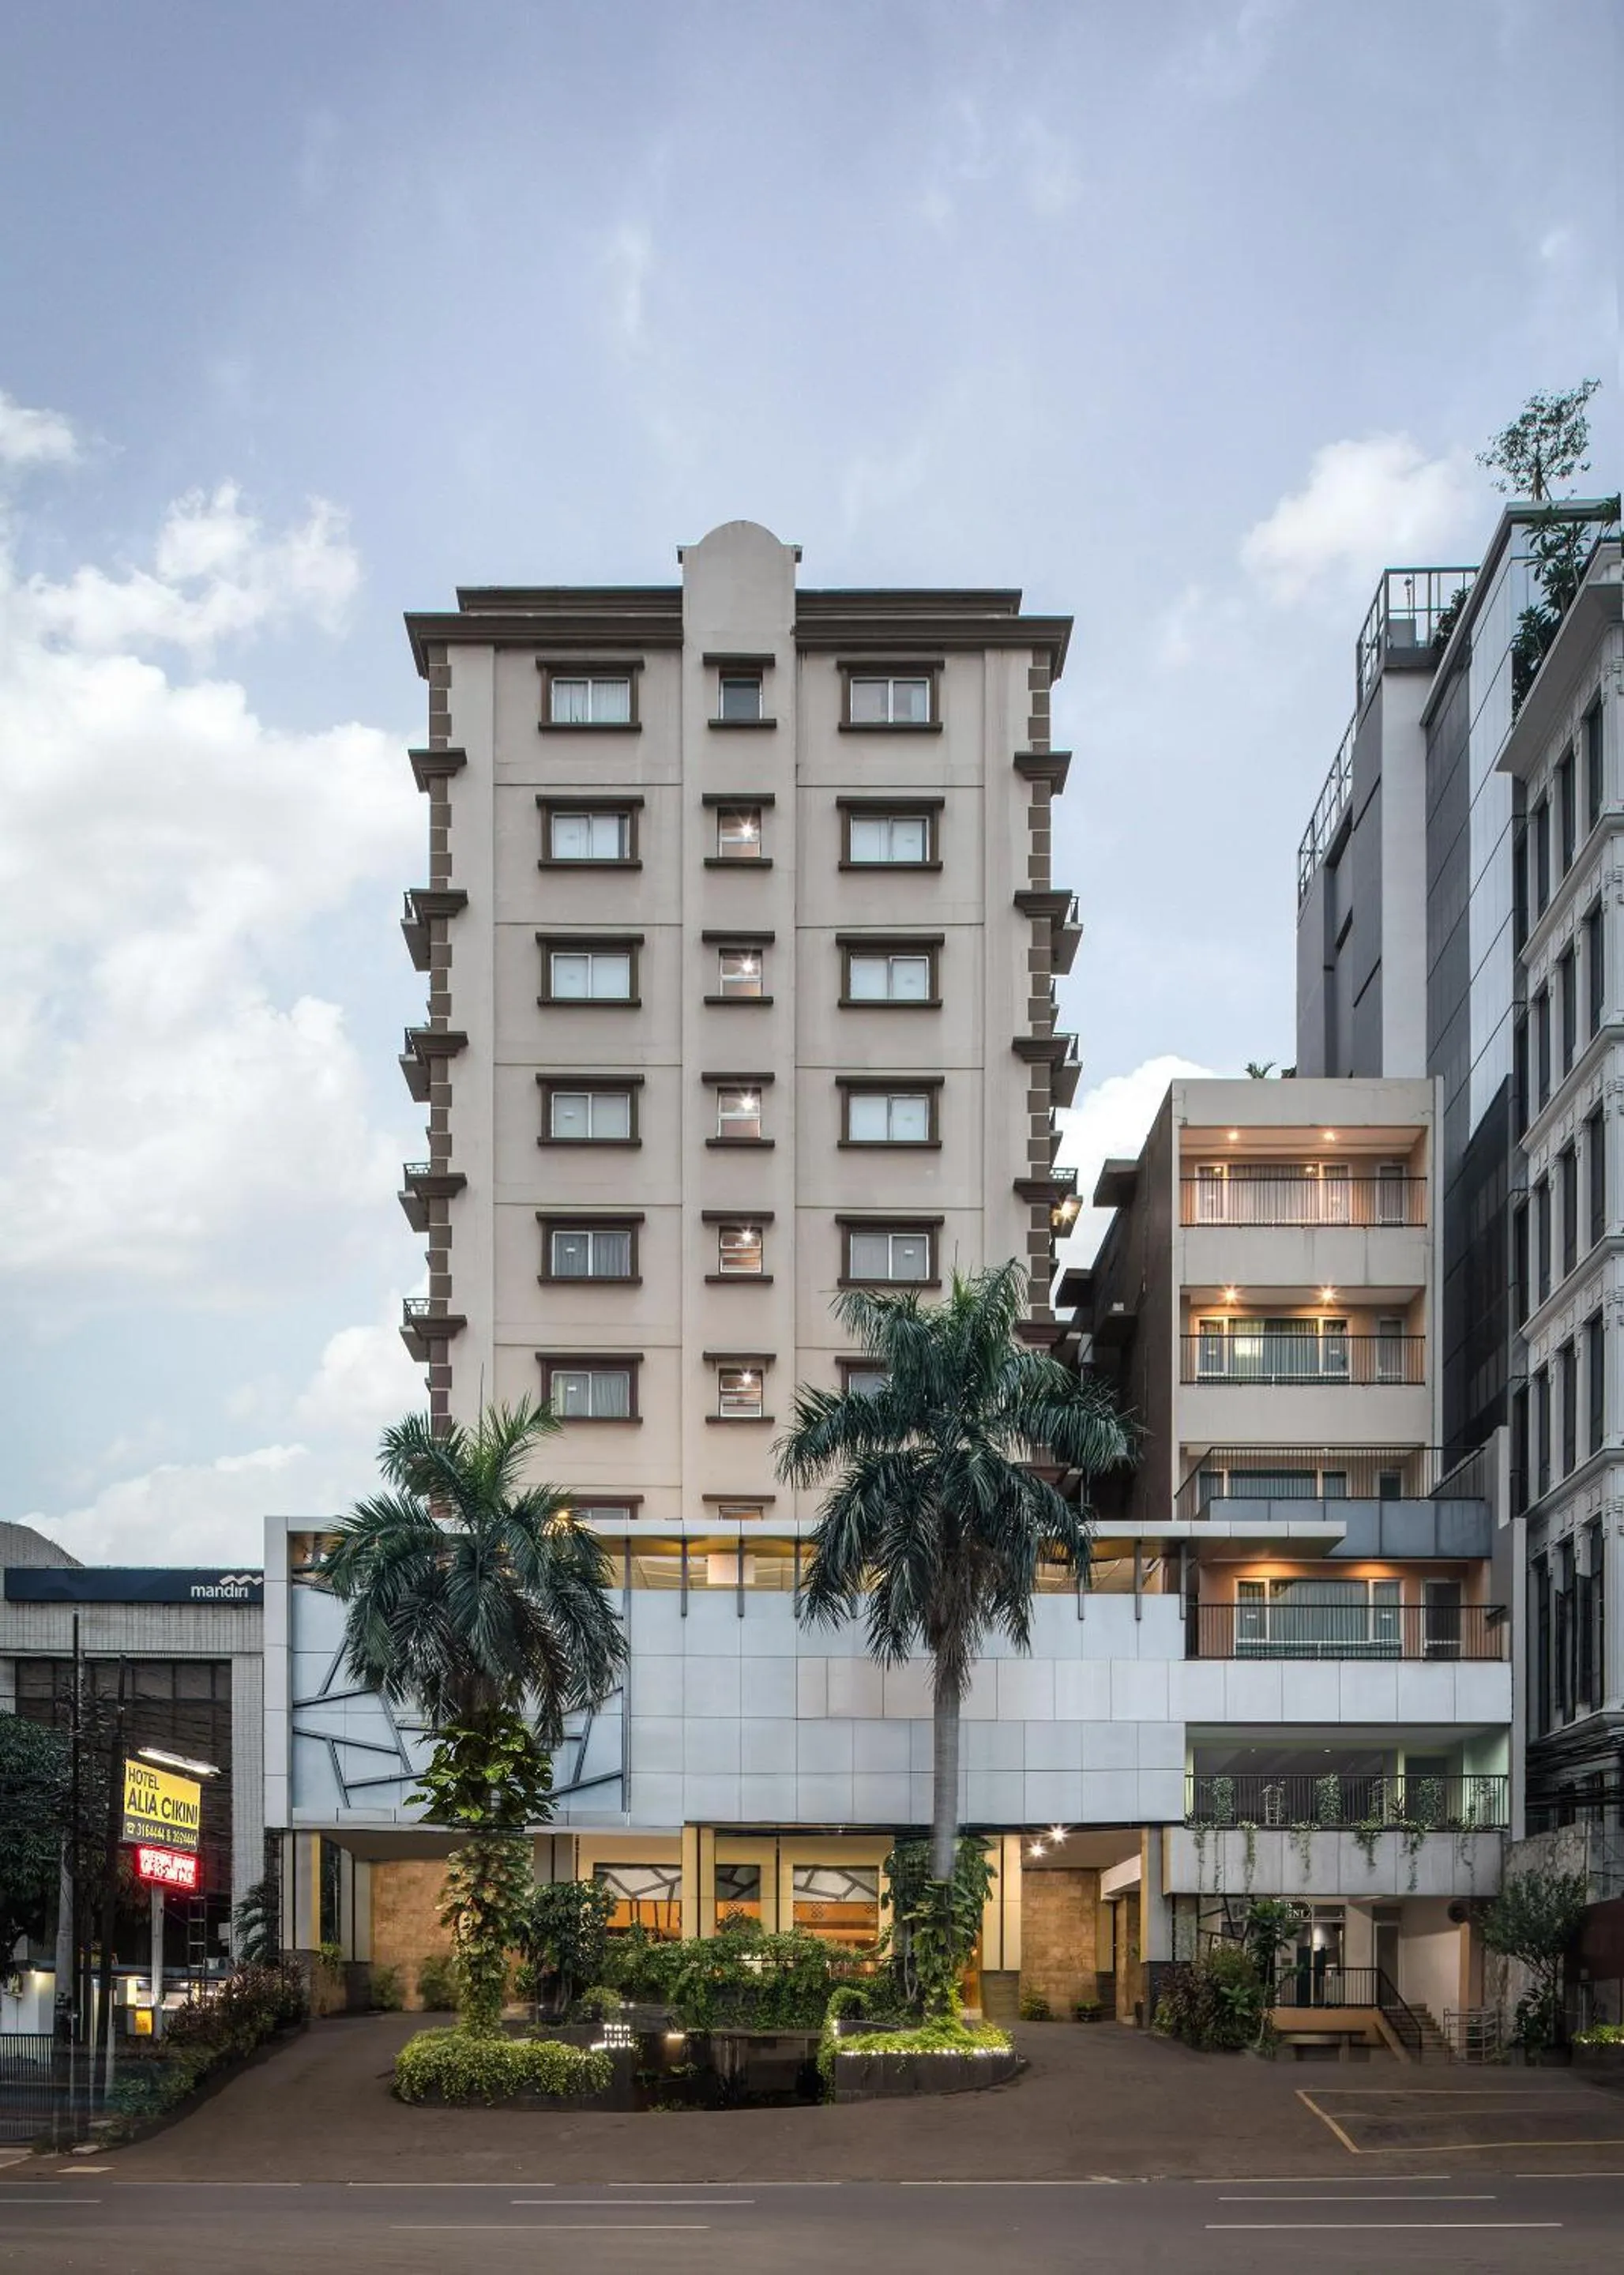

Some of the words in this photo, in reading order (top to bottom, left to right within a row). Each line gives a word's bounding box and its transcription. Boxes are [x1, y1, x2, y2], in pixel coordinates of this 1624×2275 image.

[190, 1583, 248, 1598] mandiri
[128, 1767, 160, 1790] HOTEL
[127, 1788, 157, 1816] ALIA
[161, 1797, 198, 1825] CIKINI
